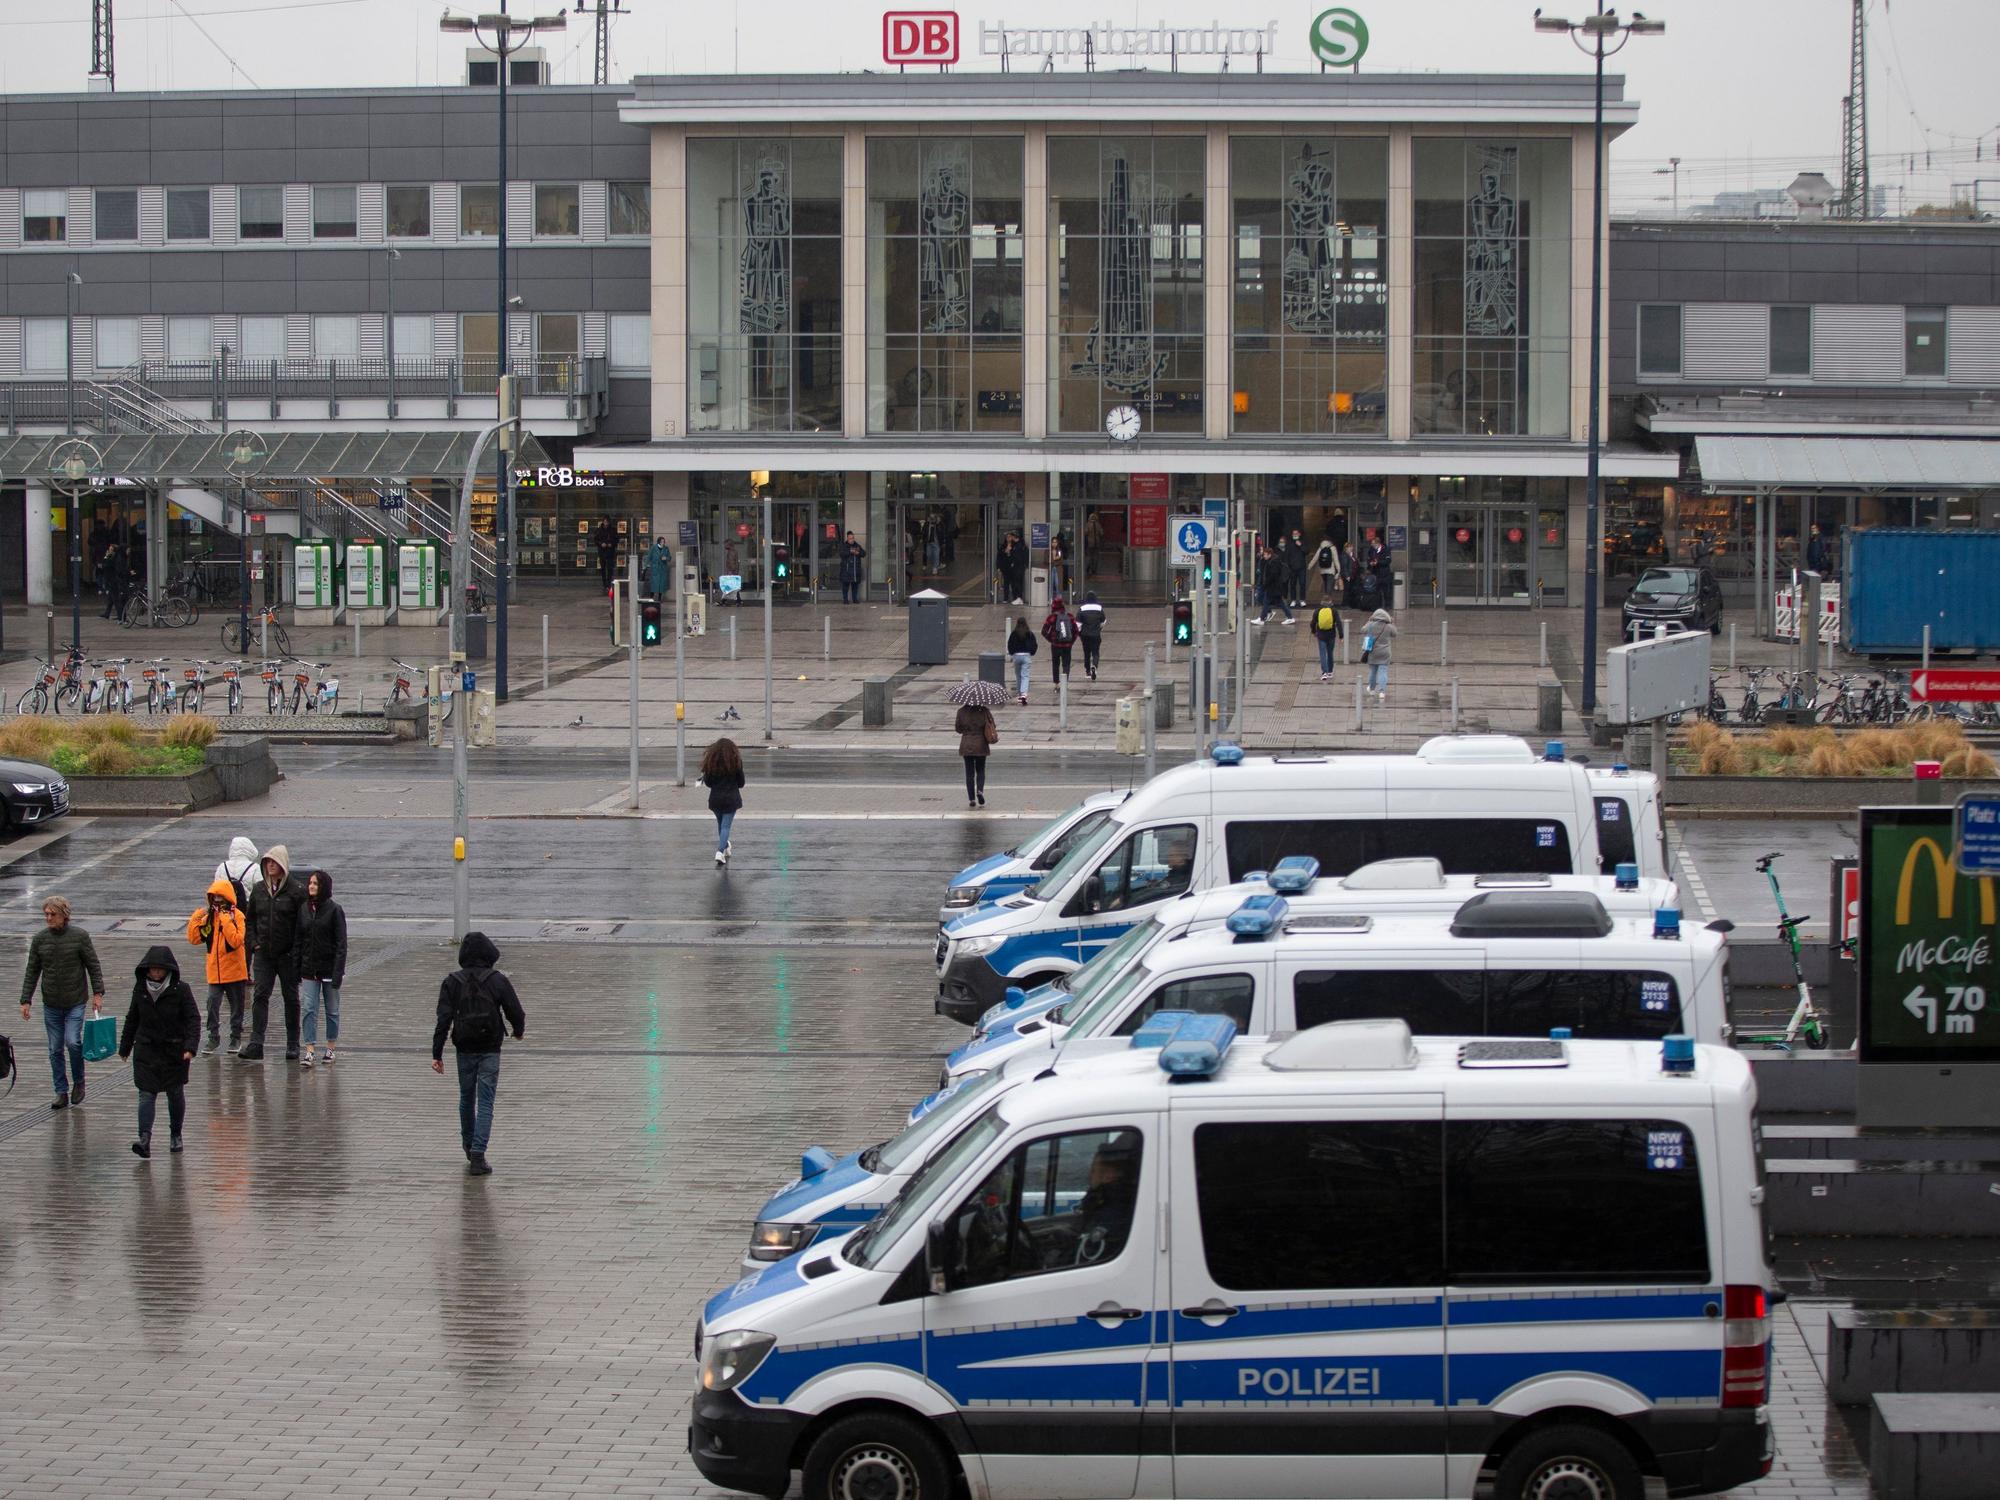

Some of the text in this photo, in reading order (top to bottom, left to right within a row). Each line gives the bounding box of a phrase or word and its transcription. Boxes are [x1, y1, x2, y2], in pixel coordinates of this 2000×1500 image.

[893, 20, 949, 54] DB
[978, 19, 1278, 64] Hauptbahnhof
[1318, 12, 1361, 63] S
[538, 467, 604, 487] P&B Books
[1181, 554, 1198, 563] ZON
[1967, 806, 1996, 824] Platz
[1896, 935, 1990, 974] McCafé
[1641, 991, 1669, 1001] 31133
[1642, 981, 1669, 991] NRW
[1945, 986, 1986, 1012] 70
[1945, 1014, 1975, 1034] m
[1648, 1132, 1683, 1144] NRW
[1648, 1145, 1682, 1156] 31123
[1238, 1368, 1380, 1396] POLIZEI
